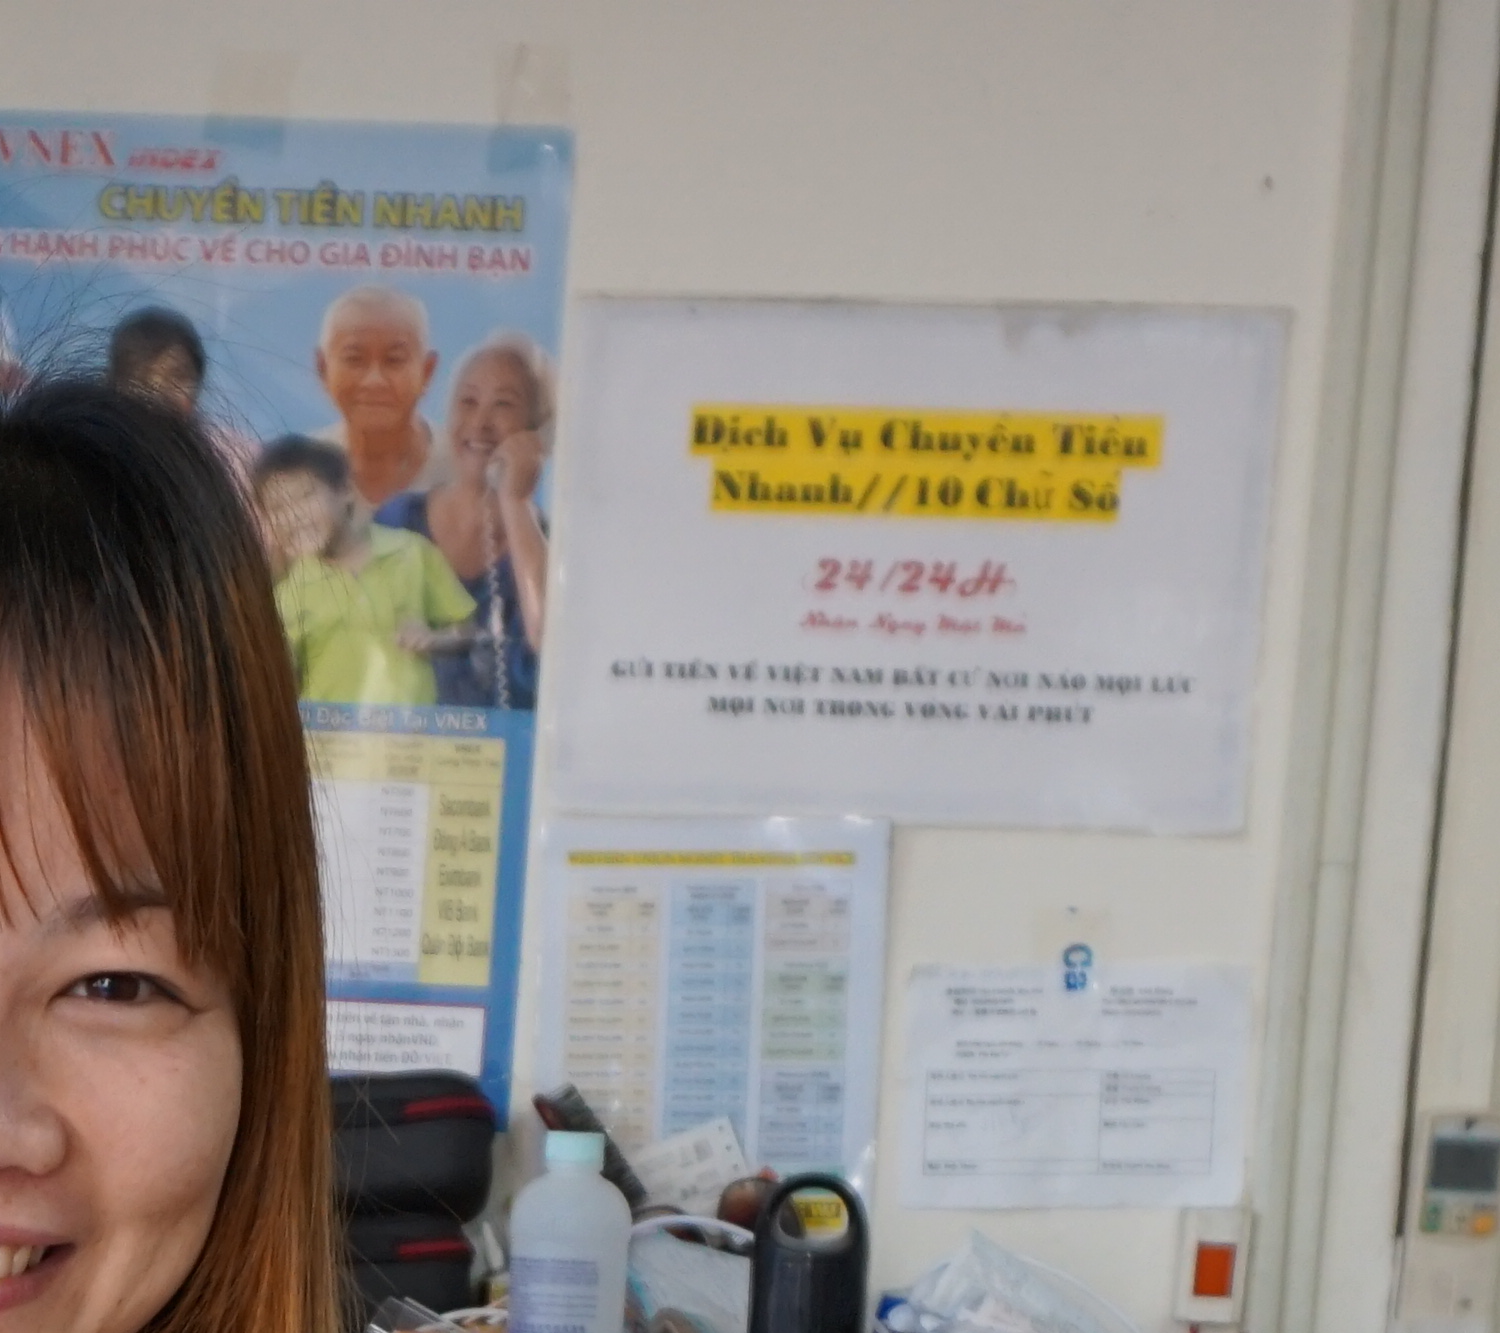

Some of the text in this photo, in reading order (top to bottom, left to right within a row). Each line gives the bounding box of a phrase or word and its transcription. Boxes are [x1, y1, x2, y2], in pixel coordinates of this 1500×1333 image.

[372, 190, 527, 233] NHANH
[244, 239, 312, 266] CHO
[318, 241, 373, 268] GIA
[433, 711, 489, 732] VNEX
